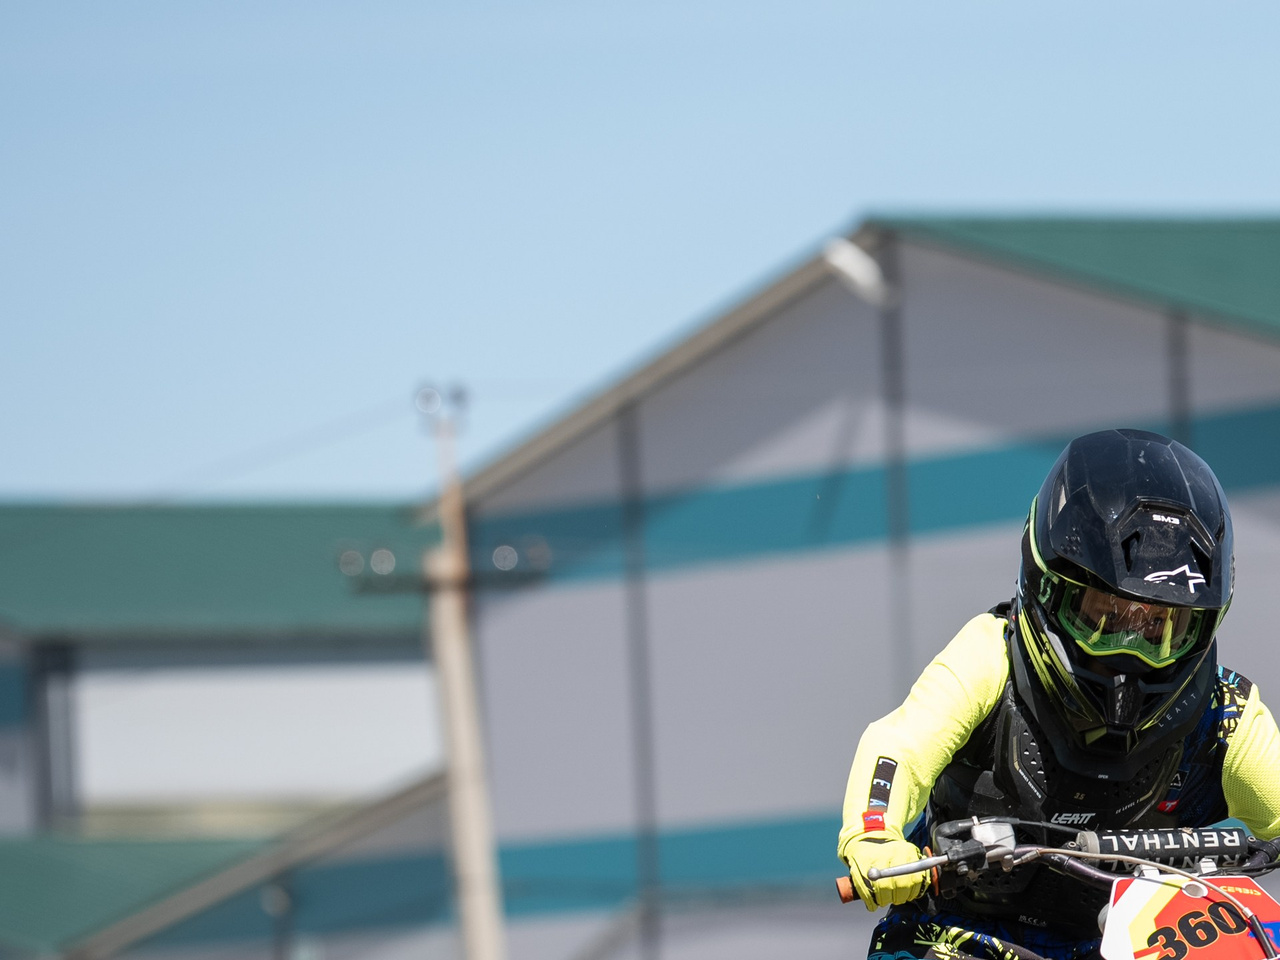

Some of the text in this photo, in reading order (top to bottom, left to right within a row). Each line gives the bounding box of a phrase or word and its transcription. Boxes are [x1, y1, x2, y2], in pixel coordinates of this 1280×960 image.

[1158, 693, 1196, 728] LEATT
[1050, 812, 1096, 825] LEATT
[1102, 831, 1241, 852] RENTHAL
[1104, 853, 1241, 872] RENTAL
[1211, 885, 1262, 896] CERBIS
